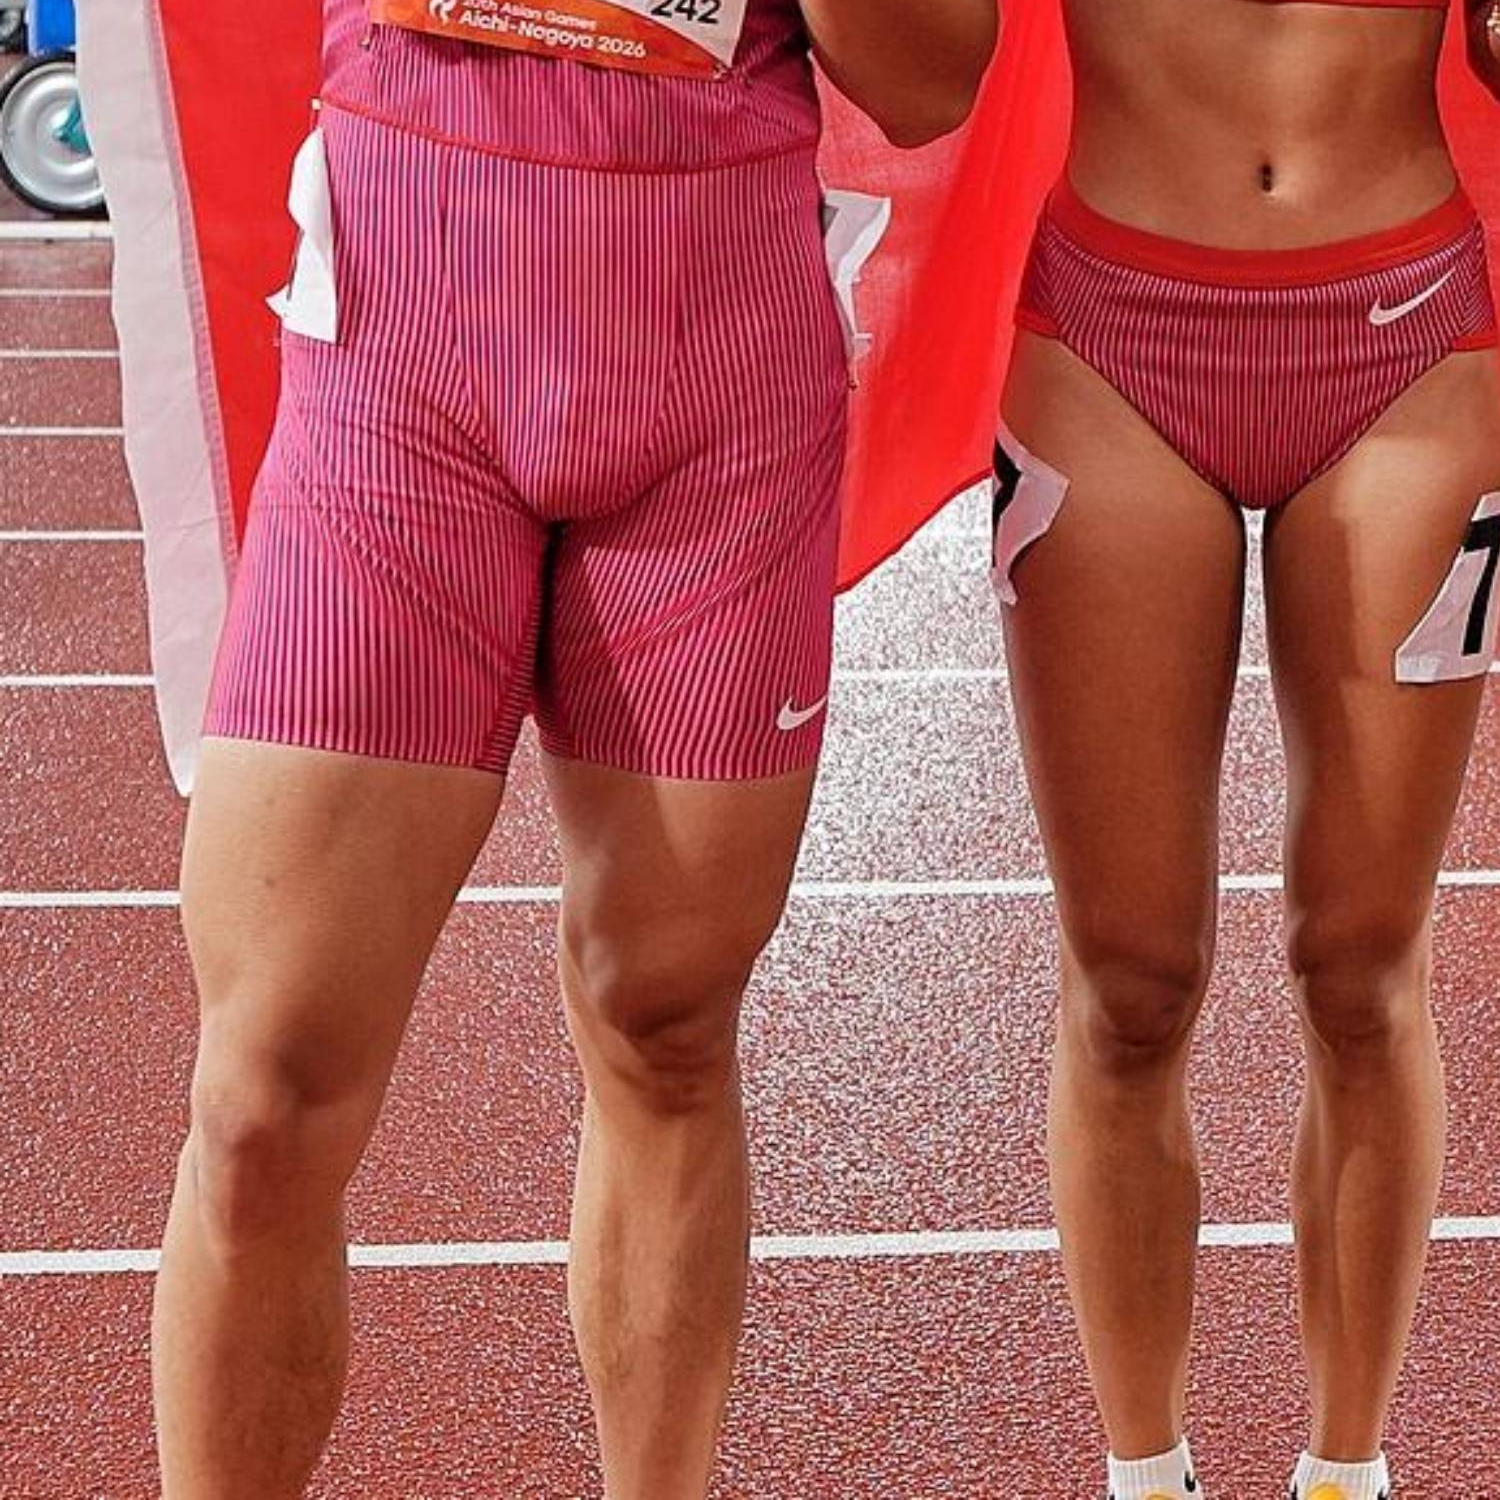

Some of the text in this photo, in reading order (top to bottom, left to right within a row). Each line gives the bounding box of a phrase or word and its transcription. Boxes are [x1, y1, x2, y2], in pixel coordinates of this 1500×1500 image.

[459, 10, 647, 58] Aichi-Nagoya 2026
[502, 2, 542, 20] Asian
[545, 11, 597, 30] Games
